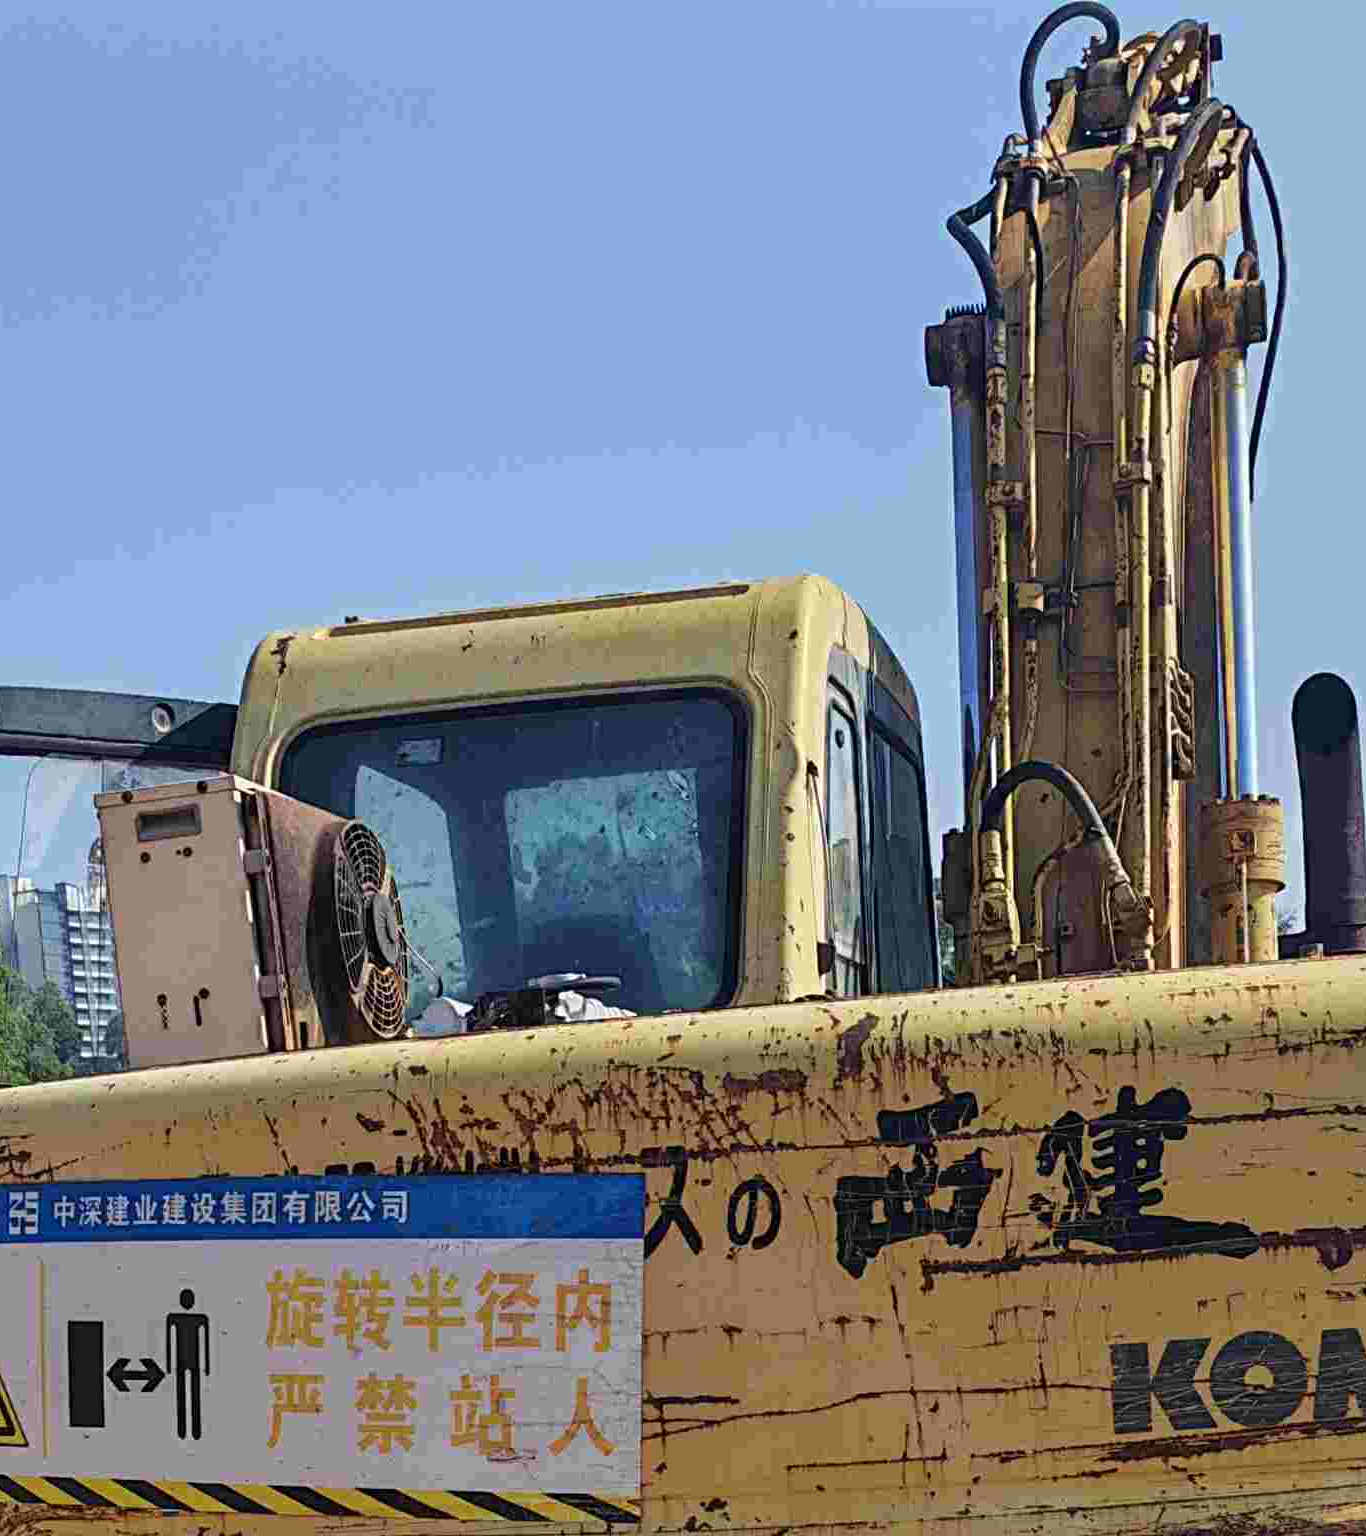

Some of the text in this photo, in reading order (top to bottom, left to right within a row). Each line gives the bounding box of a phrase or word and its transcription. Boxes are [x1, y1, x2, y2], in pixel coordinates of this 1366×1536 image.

[52, 1190, 410, 1227] 中深建业建设集团有限公司
[265, 1267, 612, 1354] 旋转半径内
[267, 1372, 616, 1457] 严禁站人
